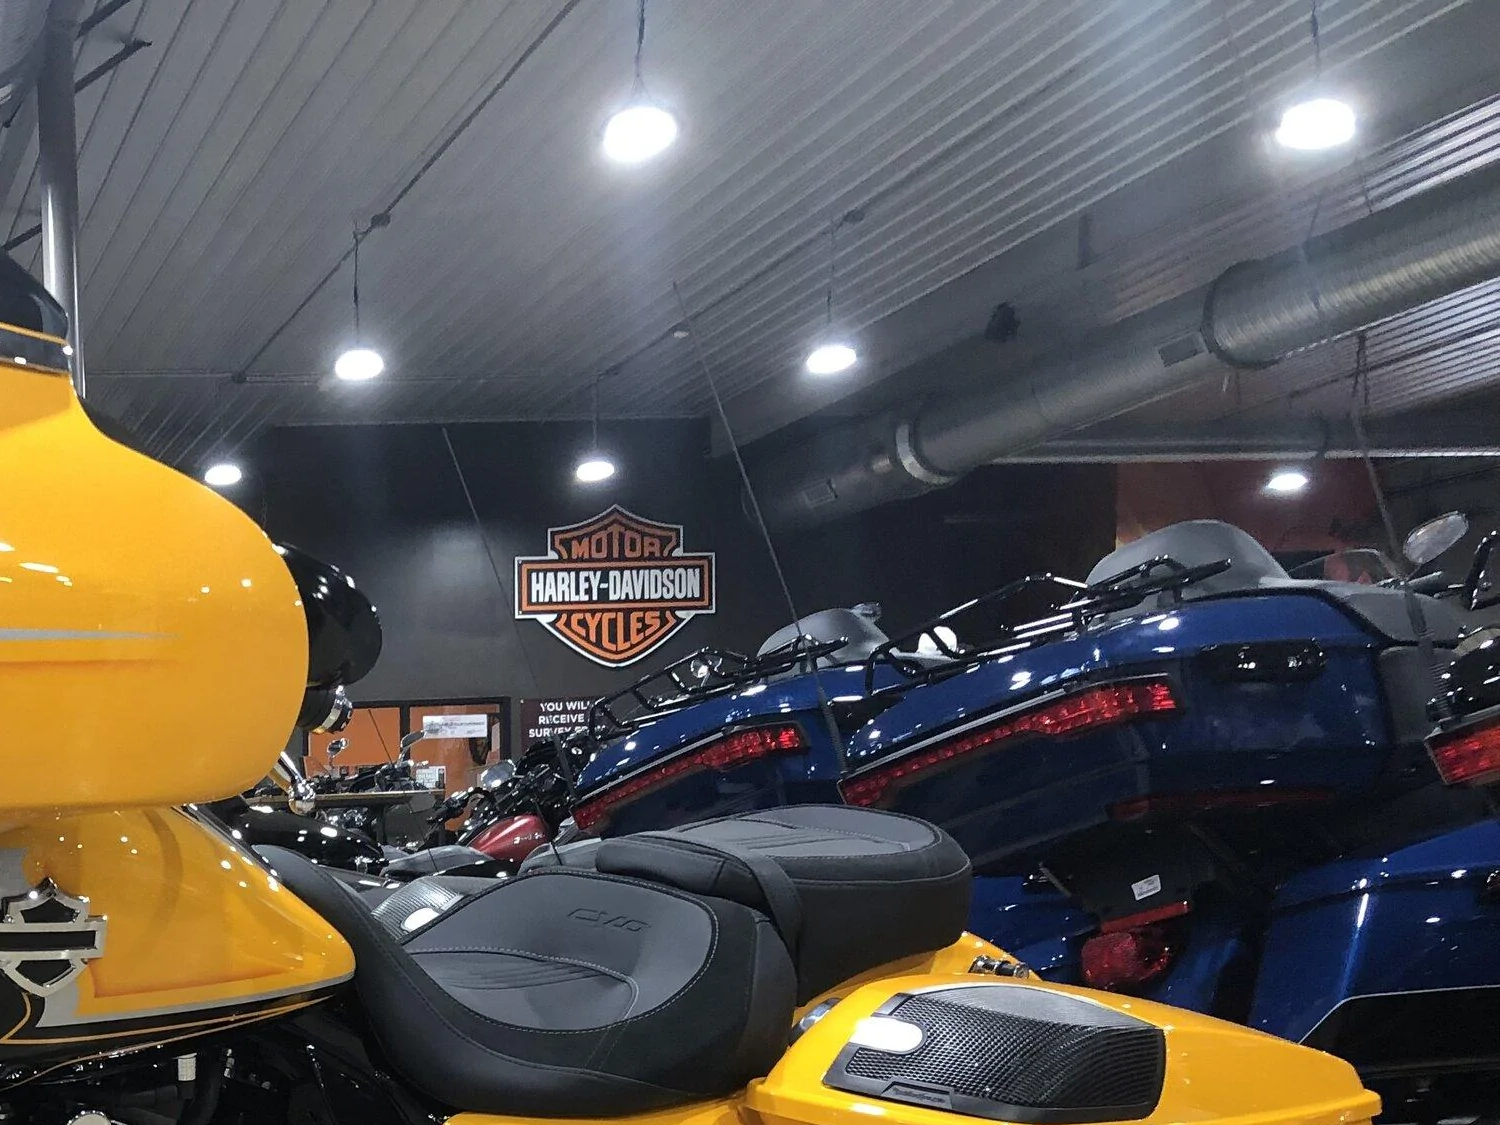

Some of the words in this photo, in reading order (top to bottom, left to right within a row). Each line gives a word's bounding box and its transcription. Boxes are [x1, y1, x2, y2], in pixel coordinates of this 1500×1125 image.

[571, 524, 663, 560] MOTOR
[531, 567, 701, 603] HARLEY-DAVIDSON
[570, 610, 663, 652] CYCLES
[540, 701, 563, 712] YOU
